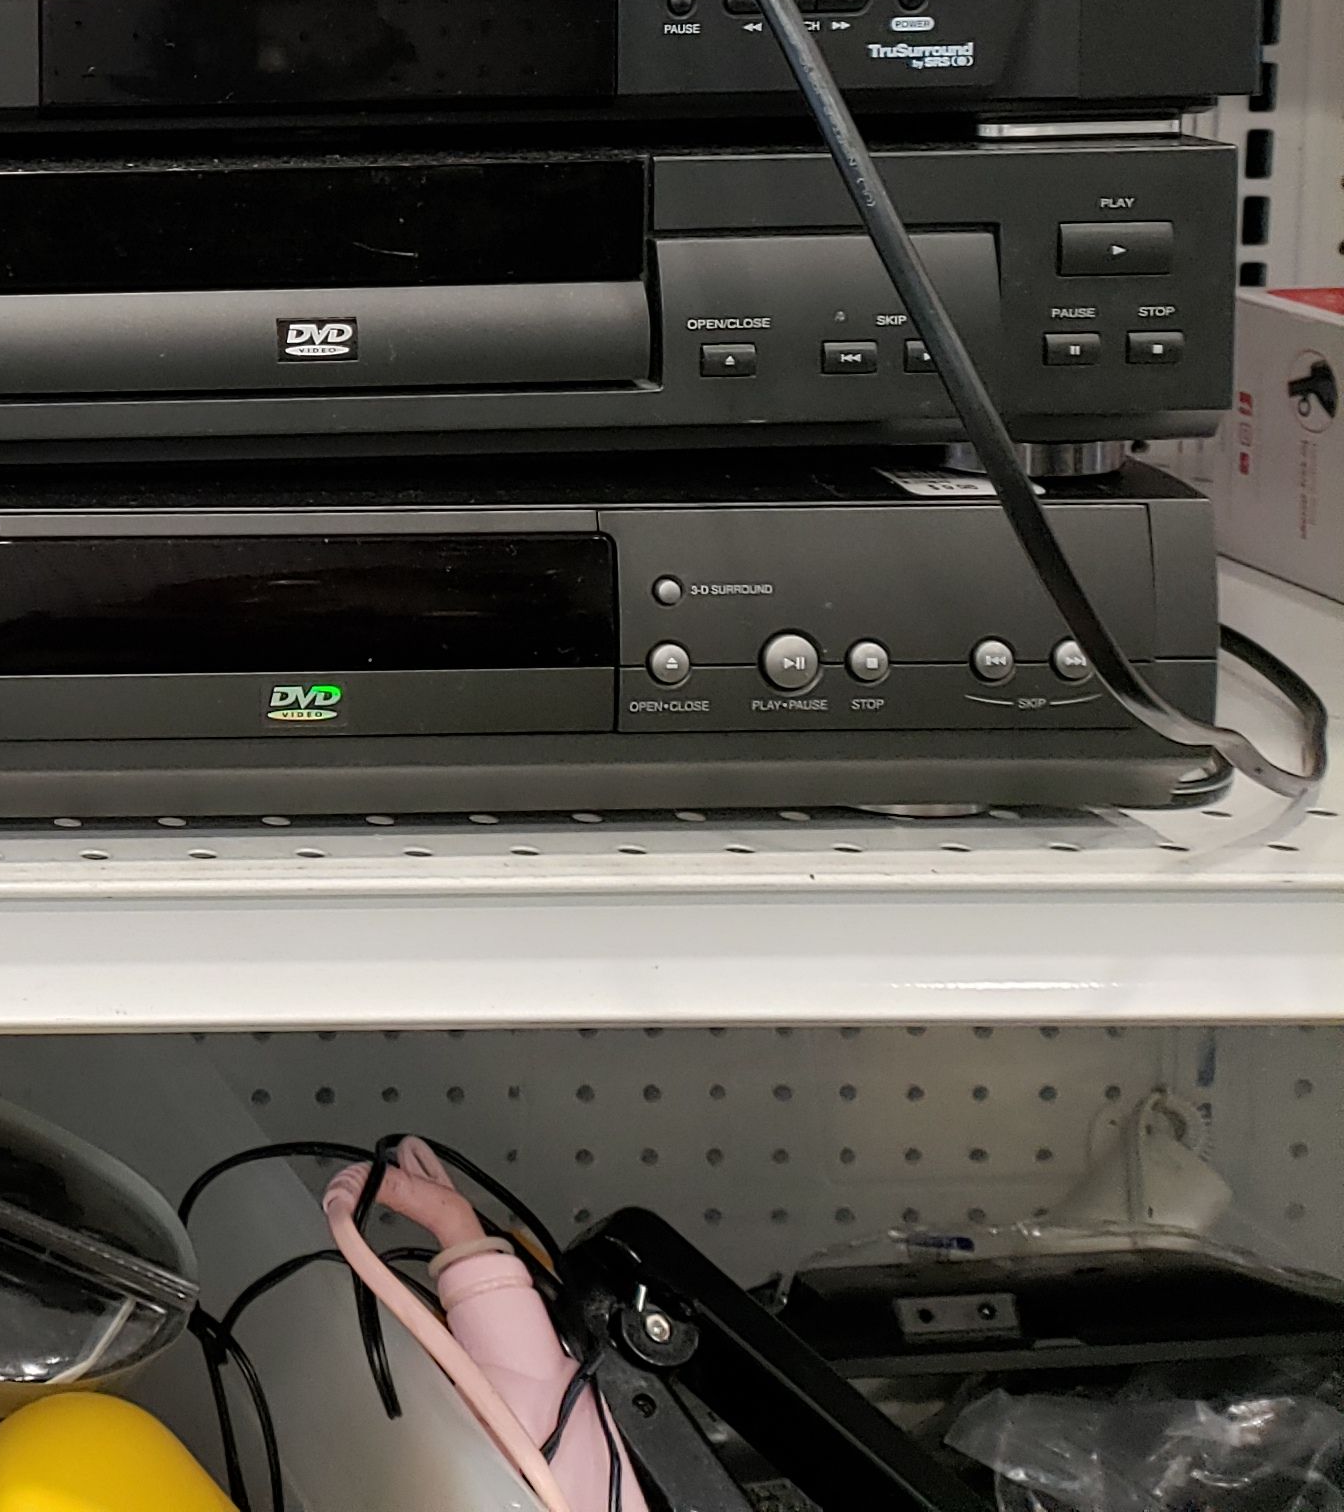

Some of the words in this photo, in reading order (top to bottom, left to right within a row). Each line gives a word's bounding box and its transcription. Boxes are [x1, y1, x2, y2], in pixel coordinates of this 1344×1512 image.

[664, 24, 700, 34] PAUSE
[867, 42, 974, 57] TruSurround
[1100, 198, 1135, 208] PLAY
[1052, 308, 1095, 318] PAUSE
[1138, 307, 1175, 317] STOP
[687, 318, 770, 330] OPEN/CLOSE
[877, 315, 907, 326] SKIP
[287, 324, 352, 345] DVD
[711, 584, 772, 595] SURROUND
[851, 699, 884, 710] STOP
[1018, 698, 1046, 709] SKIP
